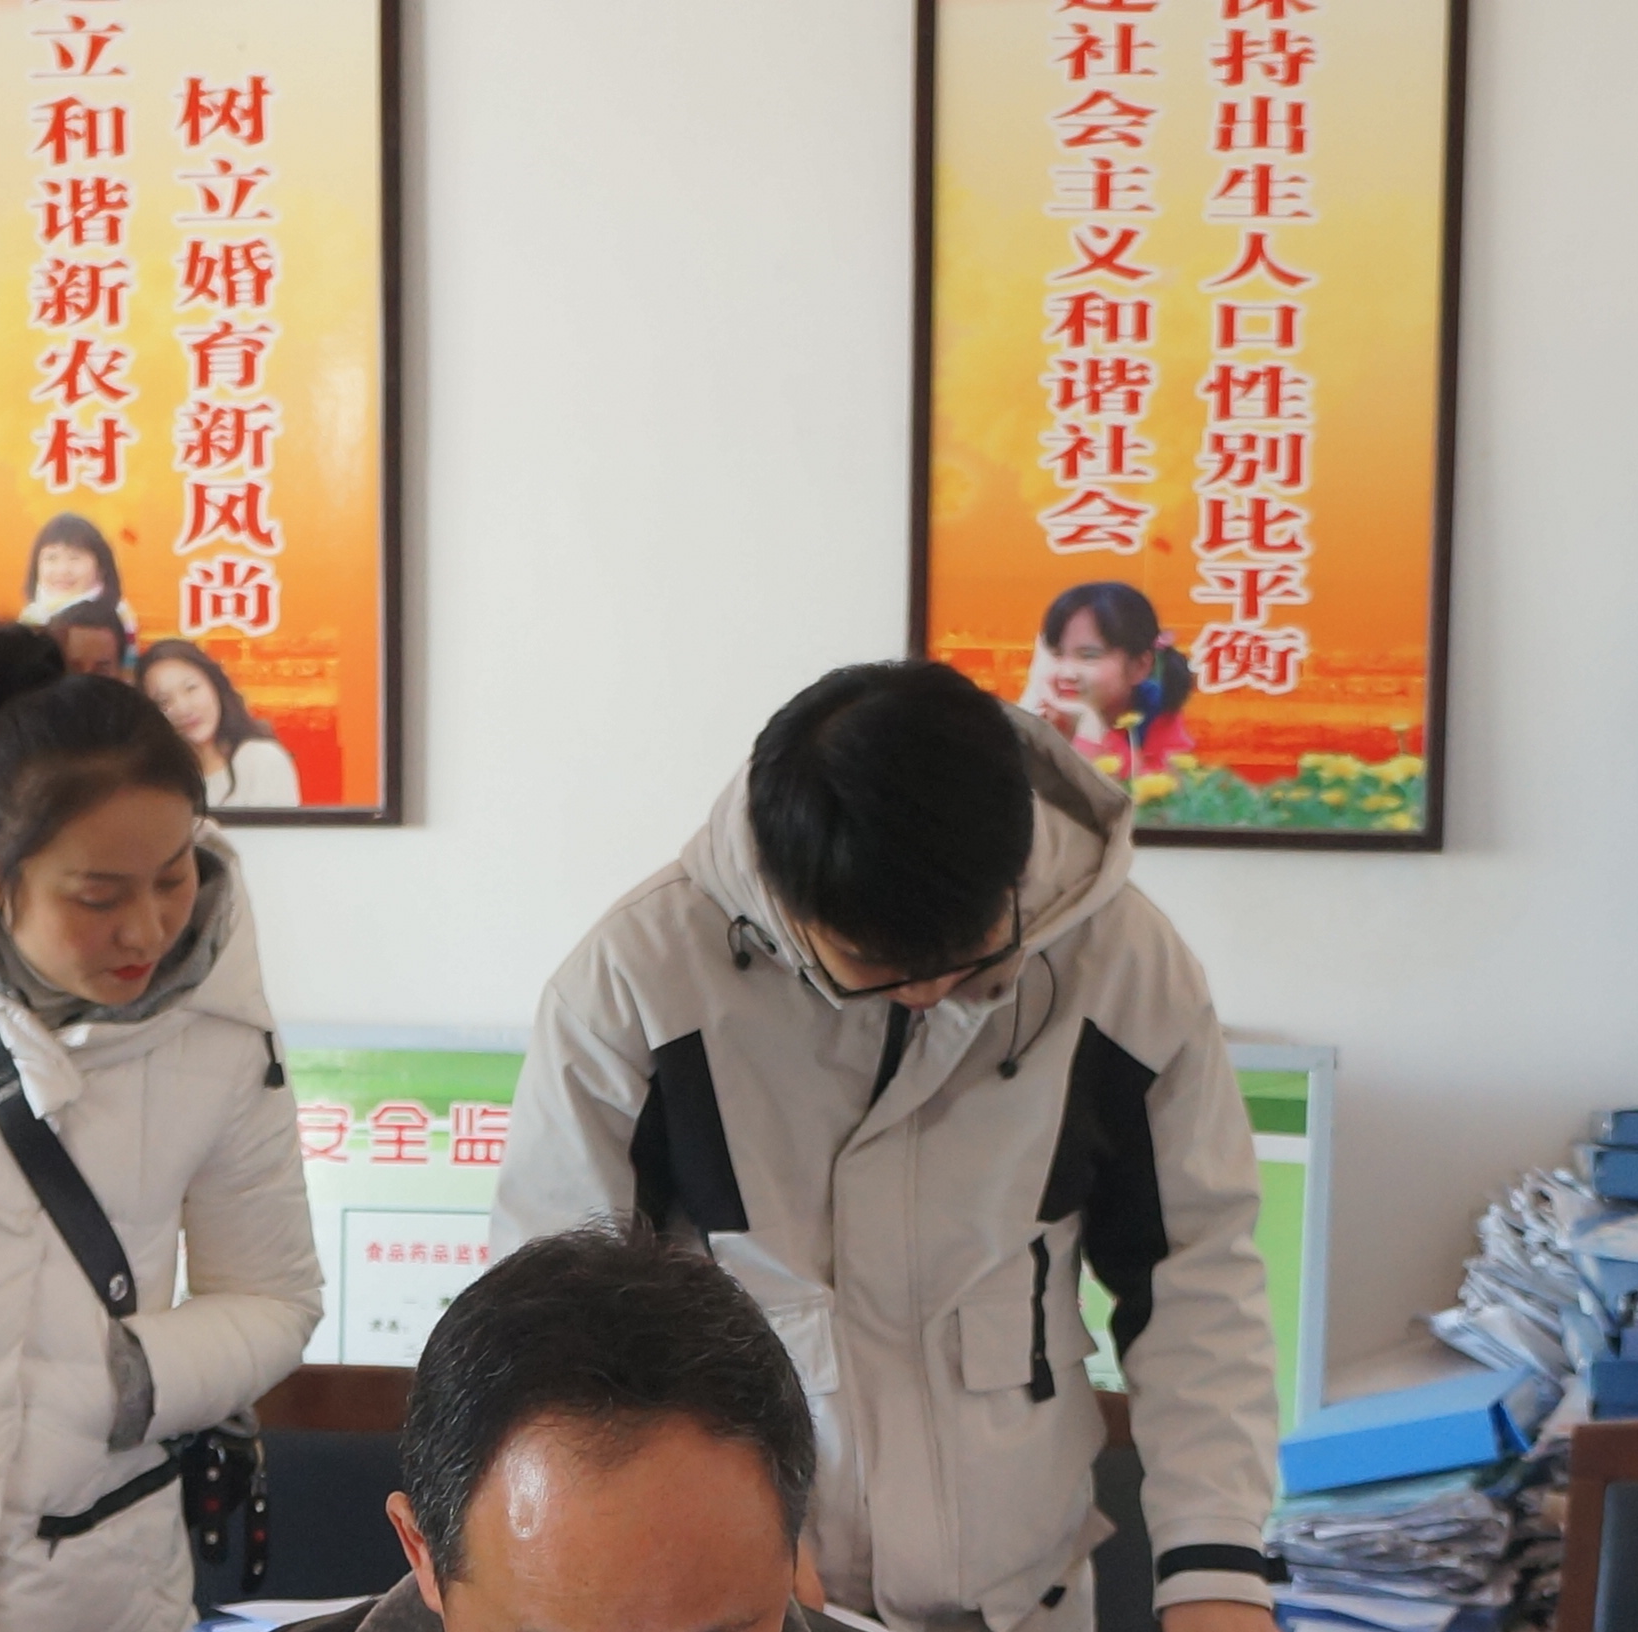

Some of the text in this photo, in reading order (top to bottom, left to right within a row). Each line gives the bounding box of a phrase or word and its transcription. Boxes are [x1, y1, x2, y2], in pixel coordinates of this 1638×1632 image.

[30, 15, 130, 489] 立和谐新农村
[176, 75, 275, 632] 树立婚育新风尚
[1046, 0, 1158, 551] 社会主义和谐社会
[1197, 0, 1316, 690] 持出生人口性别比平衡
